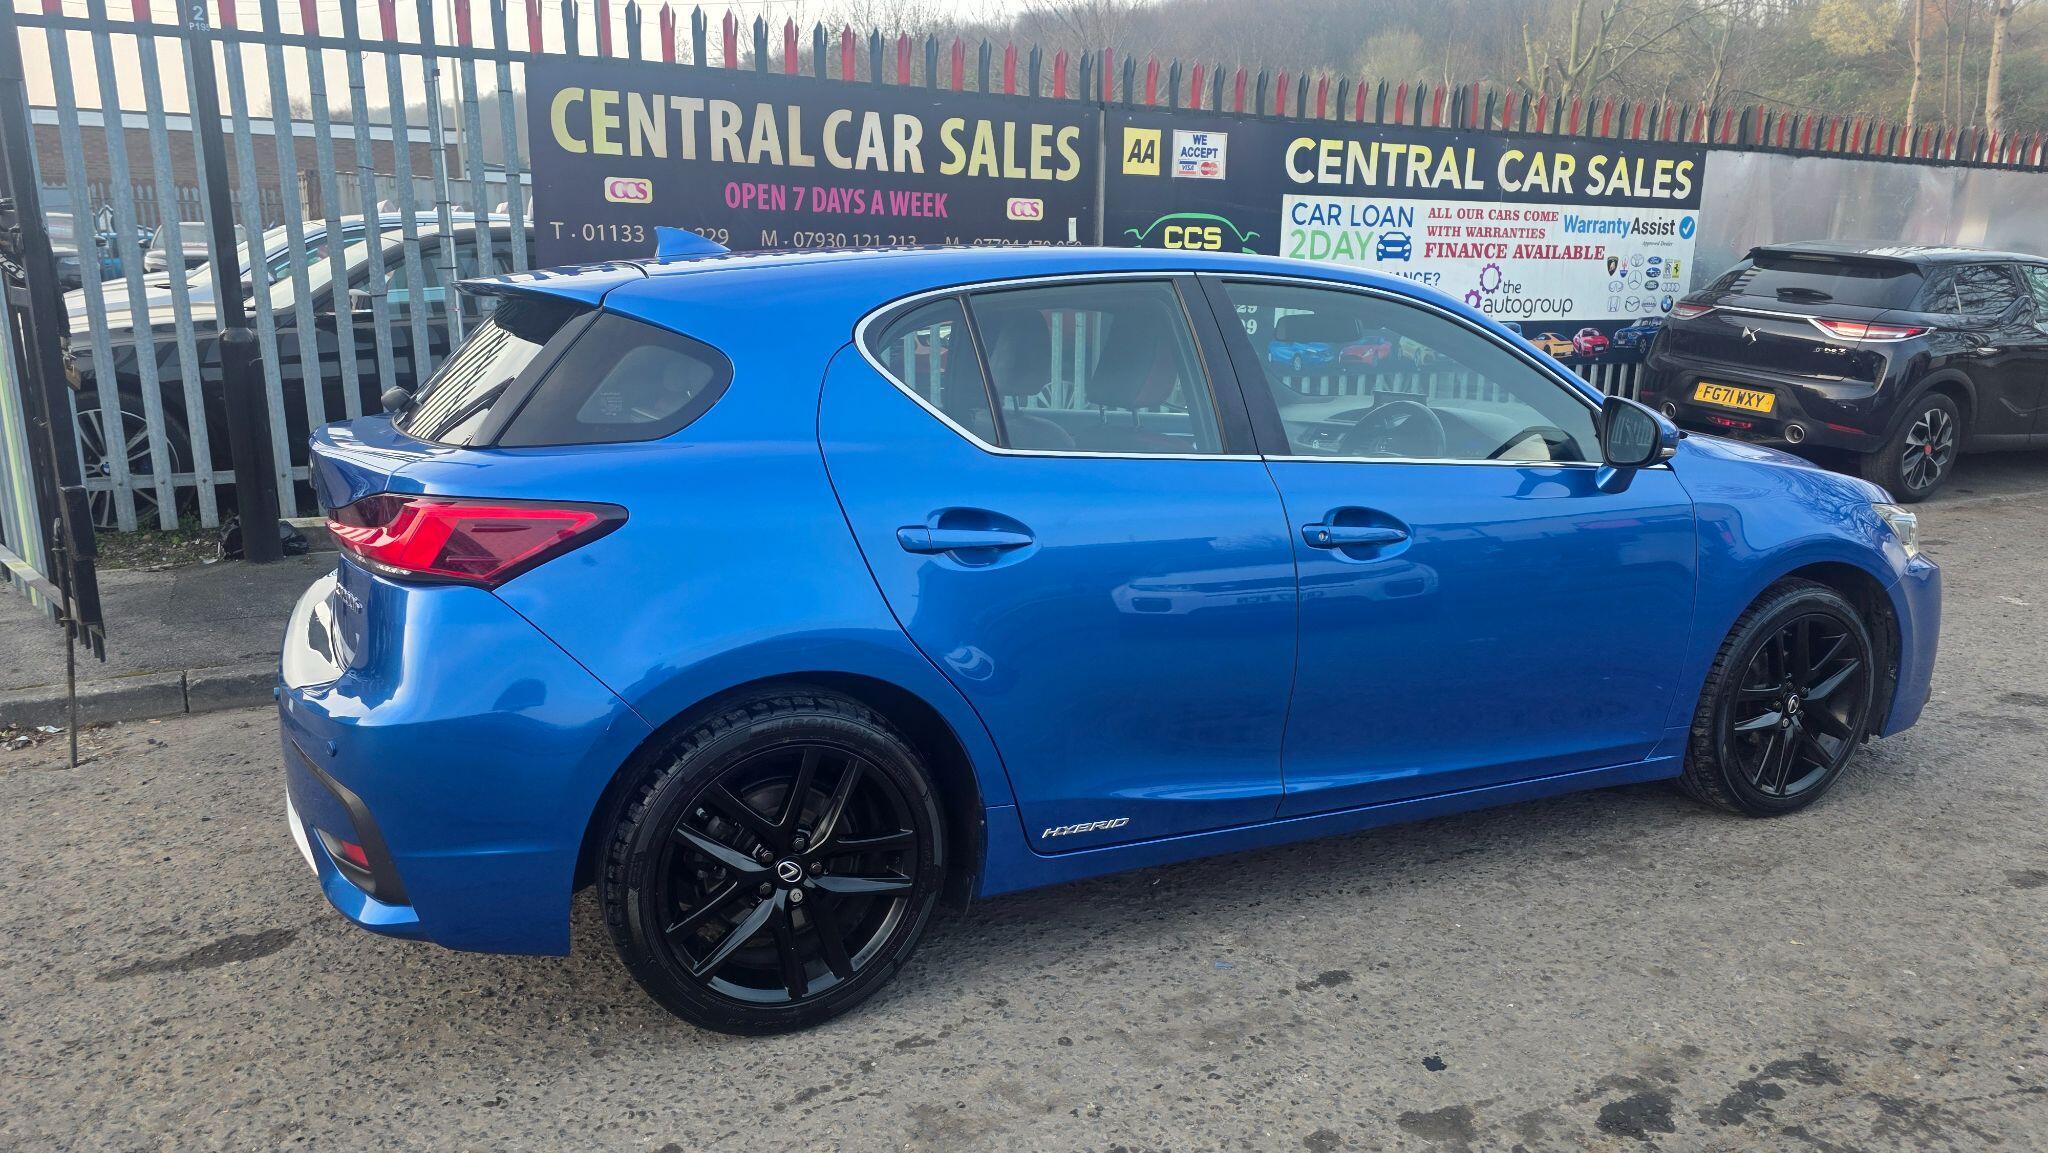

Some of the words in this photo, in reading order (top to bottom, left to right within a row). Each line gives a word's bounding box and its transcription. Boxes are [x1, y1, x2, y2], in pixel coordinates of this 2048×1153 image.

[192, 5, 204, 21] 2
[550, 87, 815, 167] CENTRAL
[823, 109, 925, 174] CAR
[940, 117, 1081, 182] SALES
[1193, 134, 1208, 145] WE
[1127, 138, 1155, 164] AA
[1181, 146, 1218, 158] ACCEPT
[1285, 136, 1484, 190] CENTRAL
[1497, 149, 1576, 194] CAR
[1585, 153, 1695, 200] SALES
[610, 180, 648, 200] CCS
[724, 181, 786, 211] OPEN
[792, 186, 805, 211] 7
[812, 186, 866, 215] DAYS
[870, 189, 884, 216] A
[889, 190, 949, 218] WEEK
[1011, 200, 1039, 218] CCS
[1292, 202, 1342, 226] CAR
[1350, 204, 1414, 228] LOAN
[1428, 207, 1453, 219] ALL
[1456, 208, 1484, 220] OUR
[1488, 209, 1520, 221] CARS
[1523, 210, 1559, 222] COME
[582, 223, 645, 243] 01133
[793, 231, 847, 249] 07930
[852, 233, 880, 247] 121
[1164, 225, 1222, 250] CCS
[1427, 225, 1462, 237] WITH
[1465, 226, 1546, 240] WARRANTIES
[1288, 229, 1375, 261] 2DAY
[1424, 242, 1508, 259] FINANCE
[1512, 244, 1606, 261] AVAILABLE
[1502, 280, 1522, 294] the
[1483, 295, 1574, 319] autogroup
[1702, 385, 1735, 402] FG71
[1736, 391, 1766, 408] WXY
[1041, 817, 1130, 839] HYBRID
